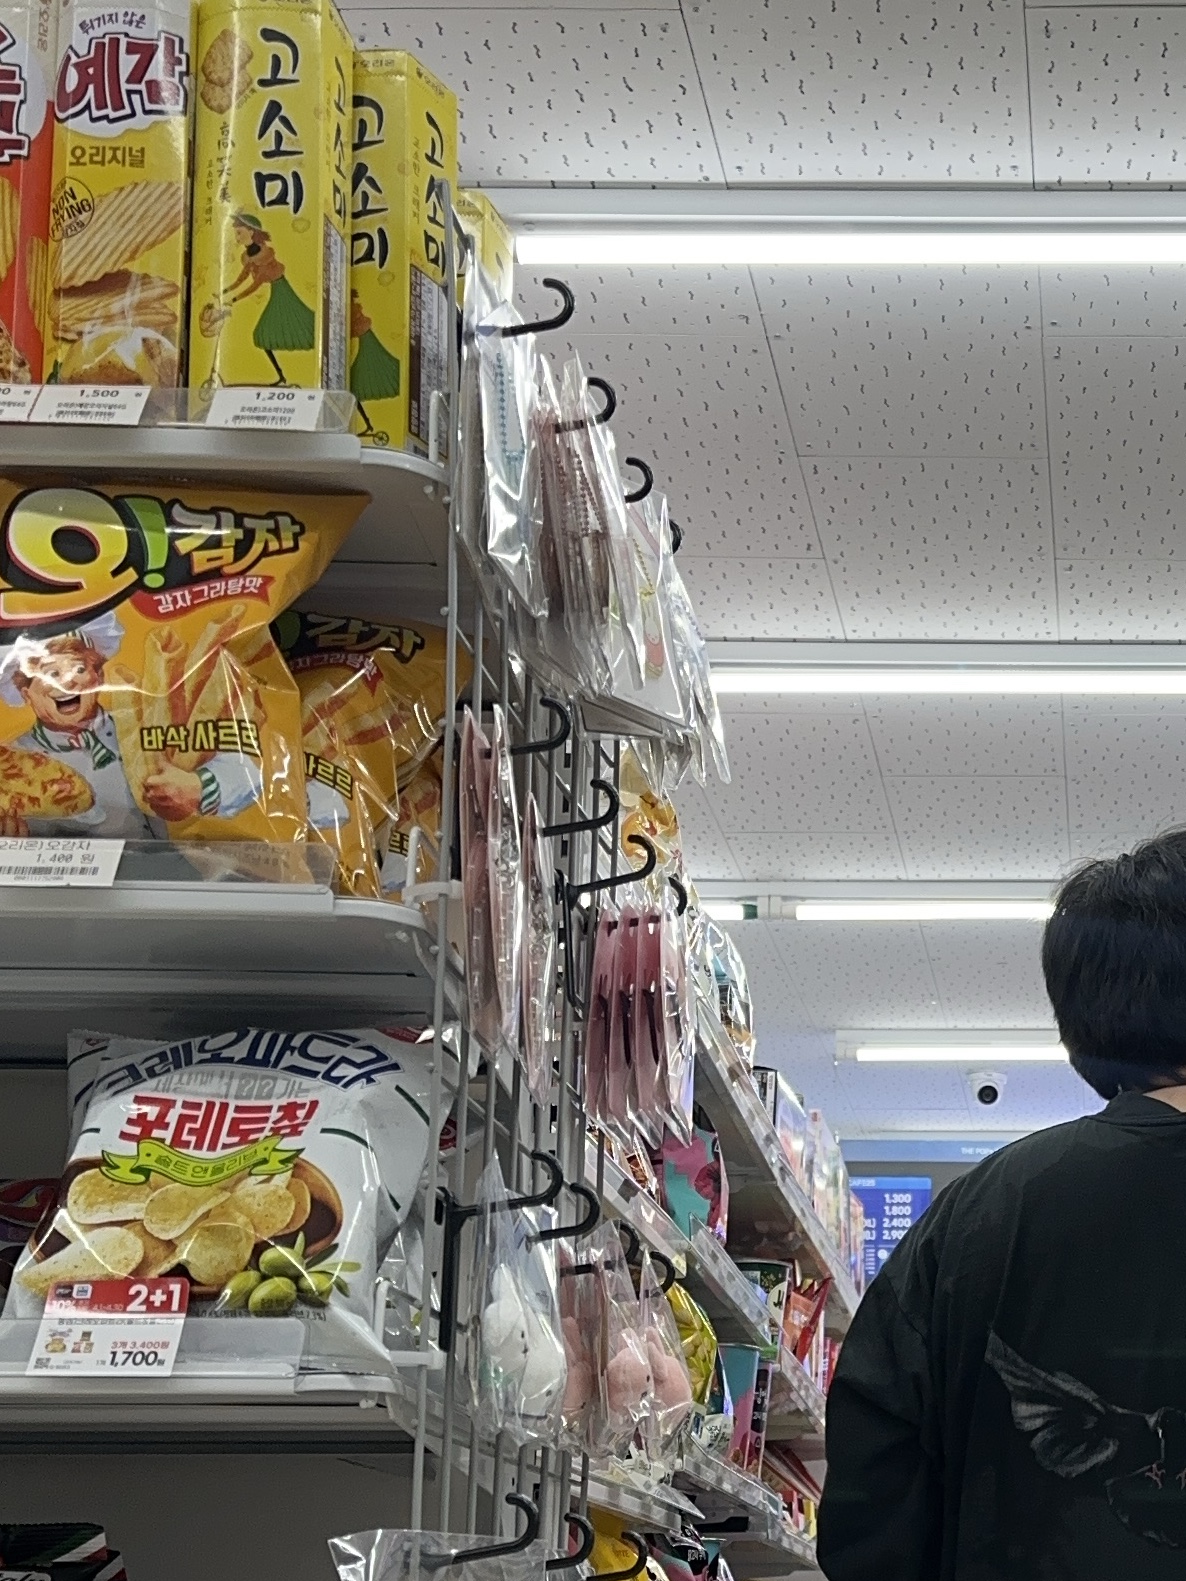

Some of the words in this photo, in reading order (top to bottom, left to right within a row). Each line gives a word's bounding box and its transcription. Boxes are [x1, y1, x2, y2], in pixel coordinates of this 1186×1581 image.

[79, 12, 119, 34] 튀기지
[123, 11, 147, 30] 않은
[56, 33, 187, 120] 예감
[254, 27, 304, 215] 고소미
[69, 146, 146, 168] 오리지널
[352, 94, 389, 269] 고소미
[50, 198, 93, 240] FRYING
[52, 187, 77, 216] NON
[141, 725, 189, 752] 바삭
[193, 719, 263, 754] 사르르
[126, 1284, 182, 1313] 2+1
